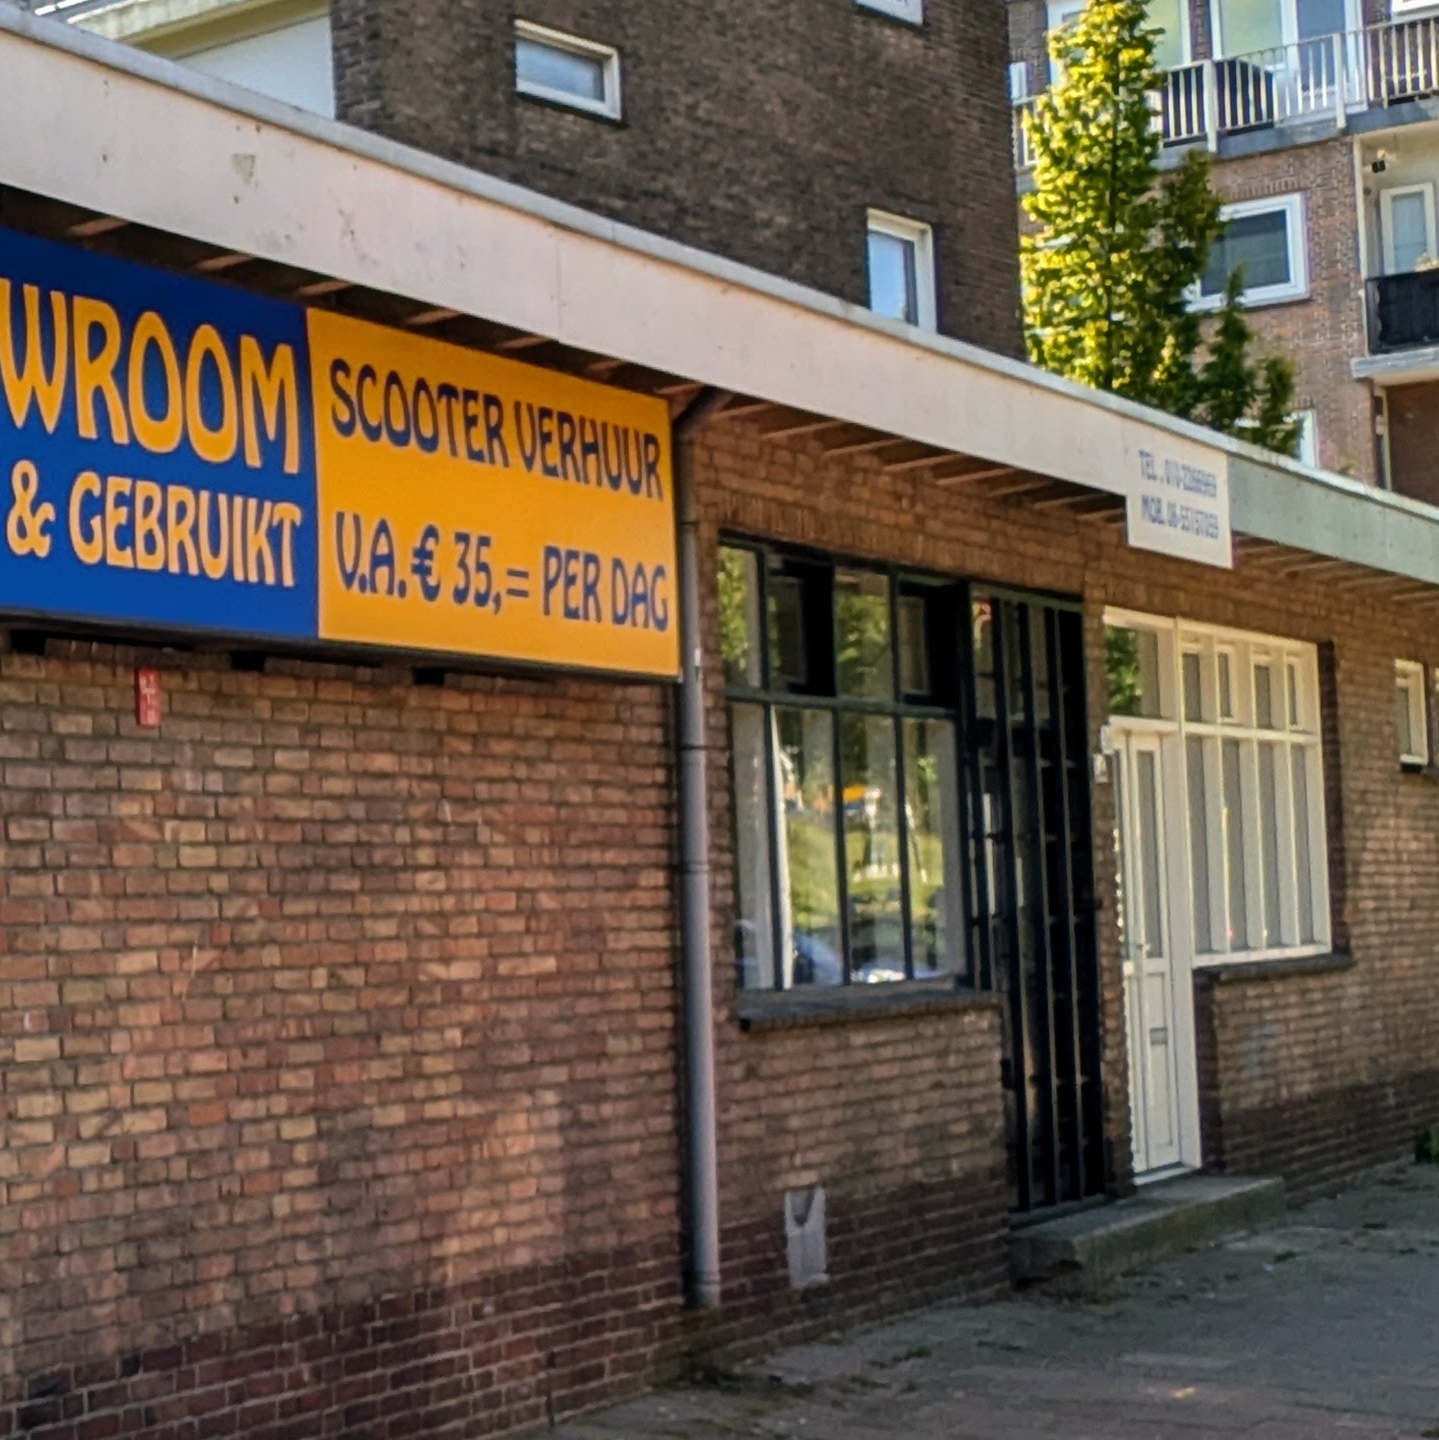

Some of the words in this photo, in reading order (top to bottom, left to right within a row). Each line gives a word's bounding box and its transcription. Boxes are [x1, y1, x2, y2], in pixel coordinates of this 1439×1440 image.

[329, 357, 510, 469] SCOOTER
[513, 400, 664, 503] VERHUUR
[6, 459, 56, 558] &
[68, 470, 303, 588] GEBRUIKT
[411, 523, 441, 603] €
[543, 545, 603, 624] PER
[610, 556, 669, 633] DAG
